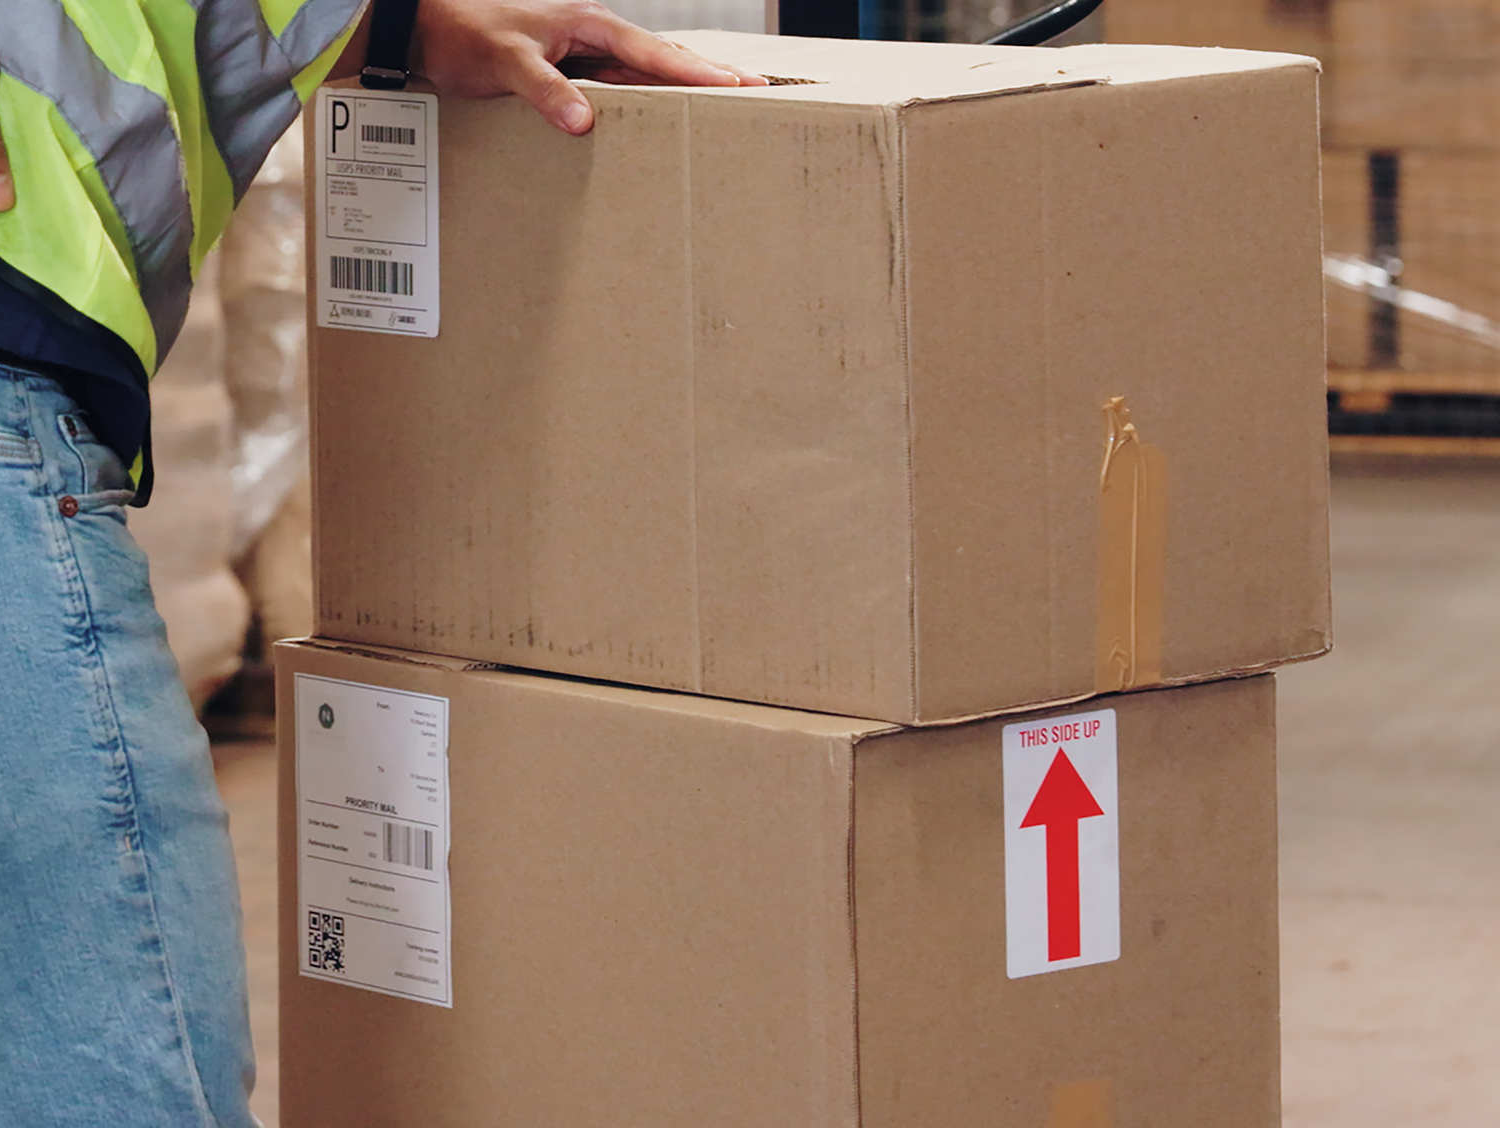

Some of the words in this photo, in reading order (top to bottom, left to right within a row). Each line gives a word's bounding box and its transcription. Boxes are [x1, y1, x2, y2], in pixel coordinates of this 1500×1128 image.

[332, 100, 349, 154] P
[355, 164, 386, 177] PRIORITY
[387, 166, 404, 179] MAIL
[1019, 727, 1048, 748] THIS
[1051, 722, 1080, 744] SIDE
[1083, 719, 1101, 738] UP
[345, 796, 379, 811] PRIORITY
[379, 802, 398, 815] MAIL
